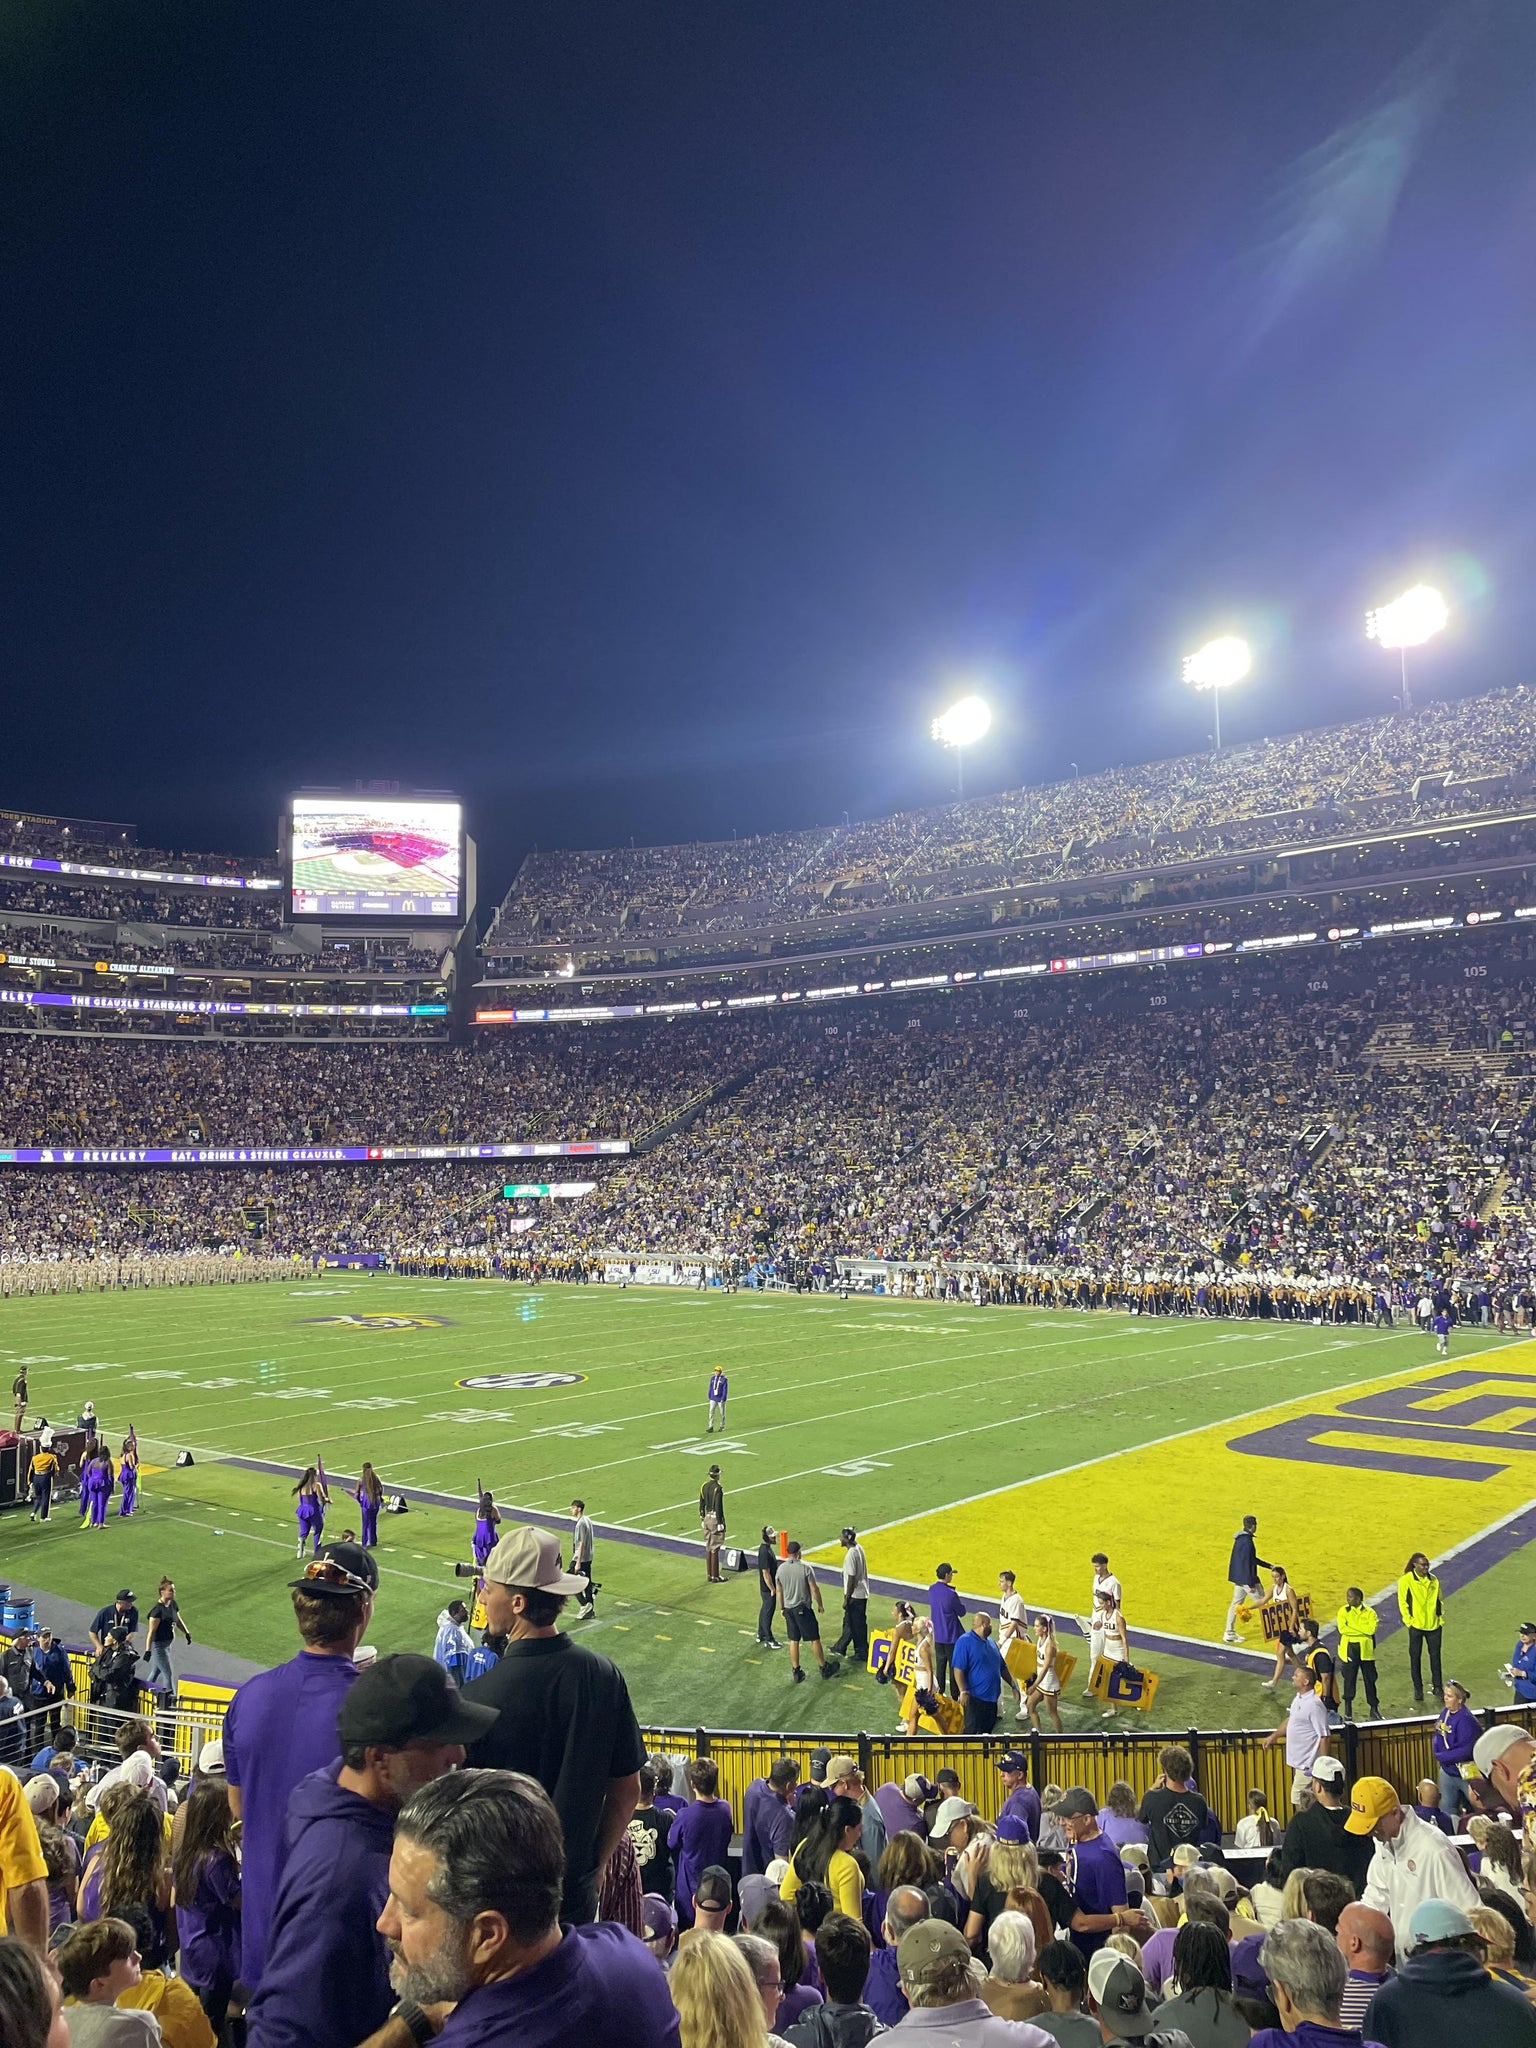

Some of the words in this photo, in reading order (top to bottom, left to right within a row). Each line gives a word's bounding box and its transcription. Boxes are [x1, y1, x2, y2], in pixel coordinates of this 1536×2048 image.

[21, 815, 57, 825] STADIUM
[9, 856, 33, 868] NOW
[8, 955, 27, 965] JERRY
[29, 957, 56, 967] STOVALL
[109, 963, 137, 973] CHARLES
[138, 965, 175, 975] ALEXANDER
[1463, 965, 1488, 978] 105
[1307, 981, 1329, 992] 104
[71, 996, 90, 1006] THE
[143, 999, 195, 1011] STANDARD
[198, 1002, 212, 1011] OF
[1150, 996, 1167, 1006] 103
[1013, 1009, 1028, 1018] 102
[907, 1019, 921, 1028] 101
[824, 1026, 838, 1035] 100
[83, 1151, 146, 1161] REVELRY
[171, 1151, 195, 1161] EAT,
[199, 1151, 235, 1161] DRINK
[239, 1152, 247, 1161] &
[250, 1151, 289, 1160] STRIKE
[292, 1150, 346, 1159] GEAUXLD.
[687, 1269, 700, 1277] LSU
[422, 1408, 516, 1423] 20
[530, 1421, 624, 1438] 15
[647, 1437, 747, 1455] 10
[821, 1460, 894, 1477] 5
[726, 1549, 737, 1568] G
